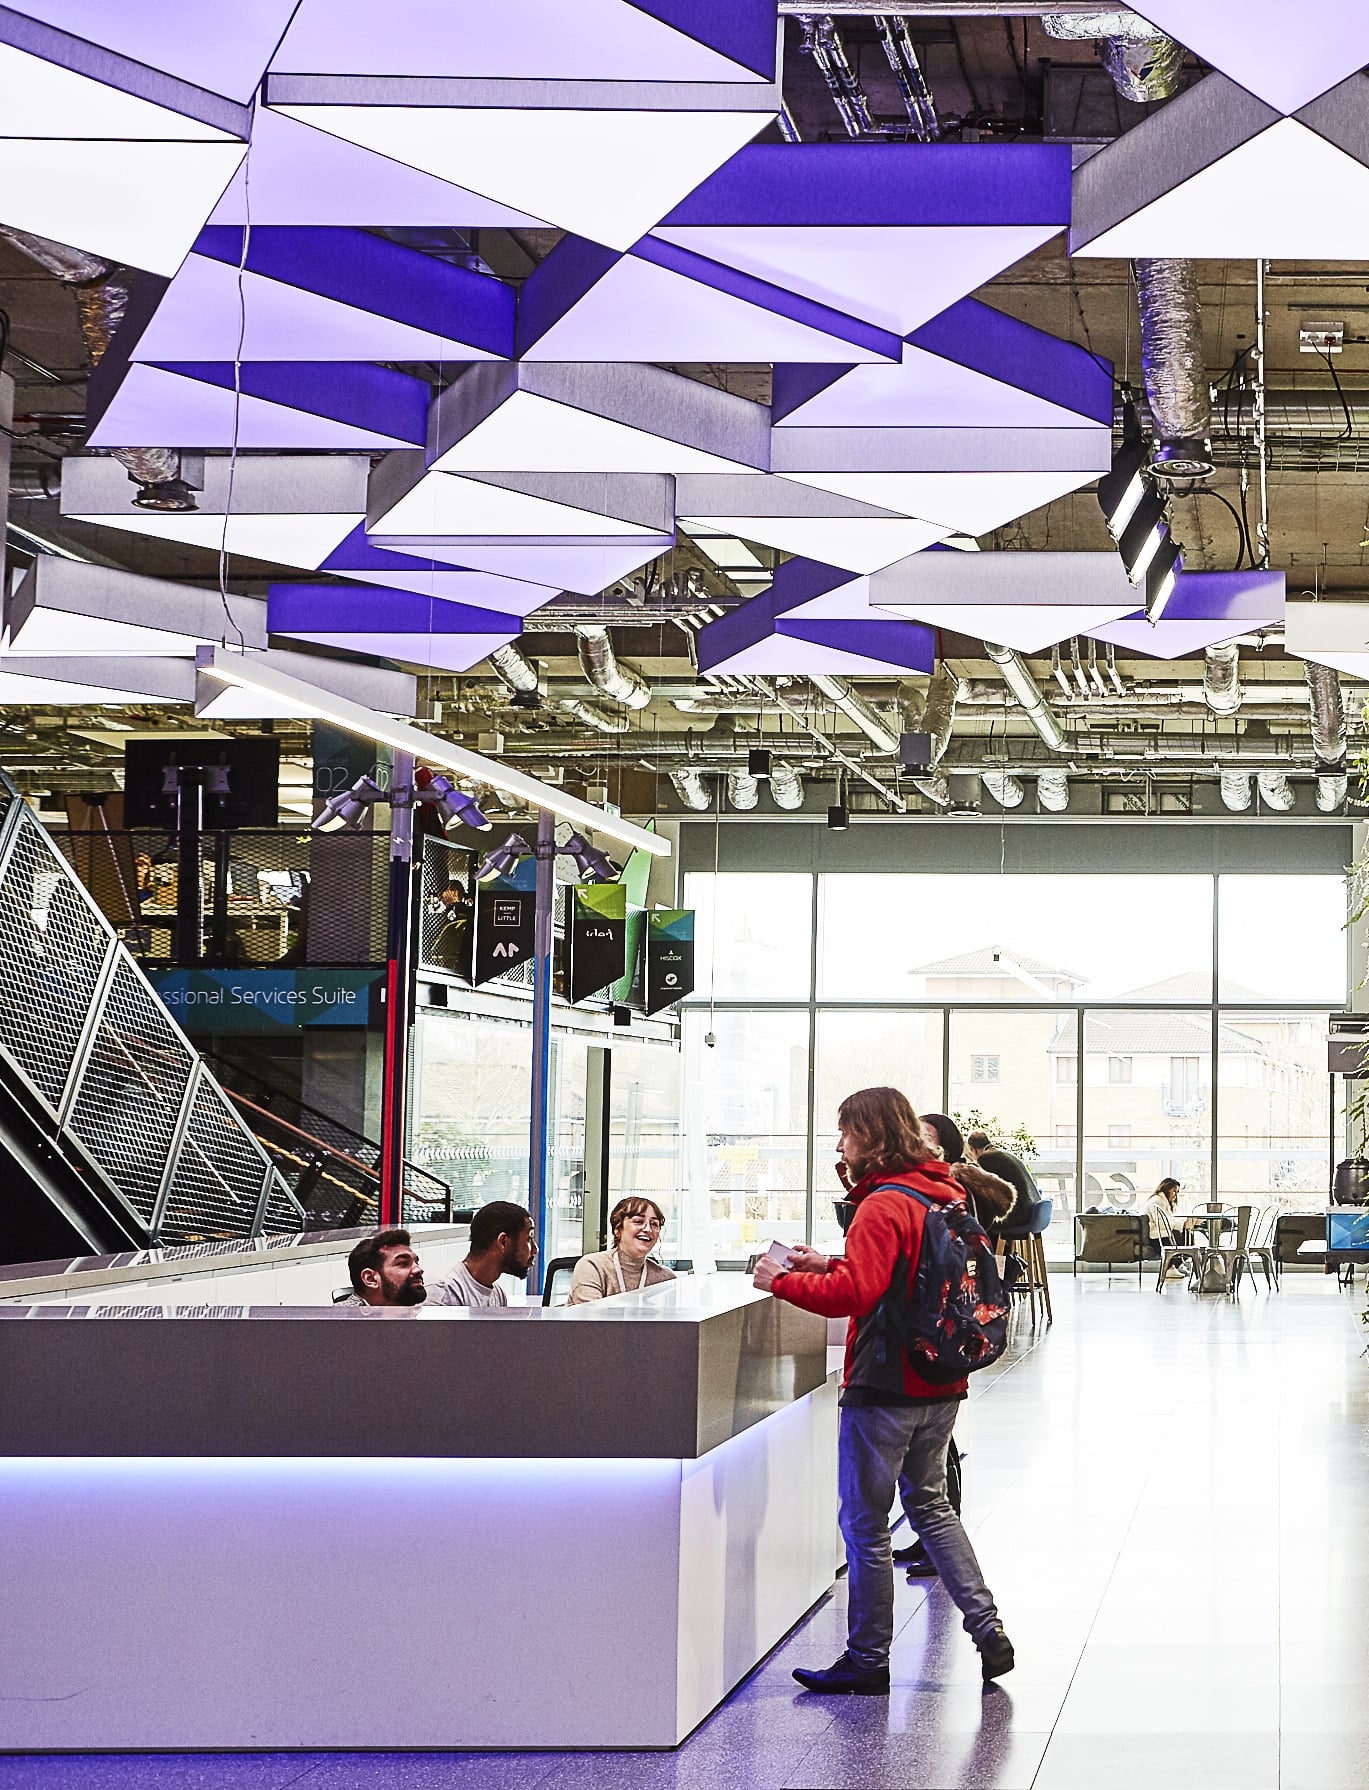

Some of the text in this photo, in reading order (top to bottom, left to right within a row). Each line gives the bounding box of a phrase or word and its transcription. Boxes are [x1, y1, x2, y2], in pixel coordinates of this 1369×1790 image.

[316, 766, 349, 792] 02
[230, 986, 307, 1005] Services
[312, 986, 357, 1005] Suite
